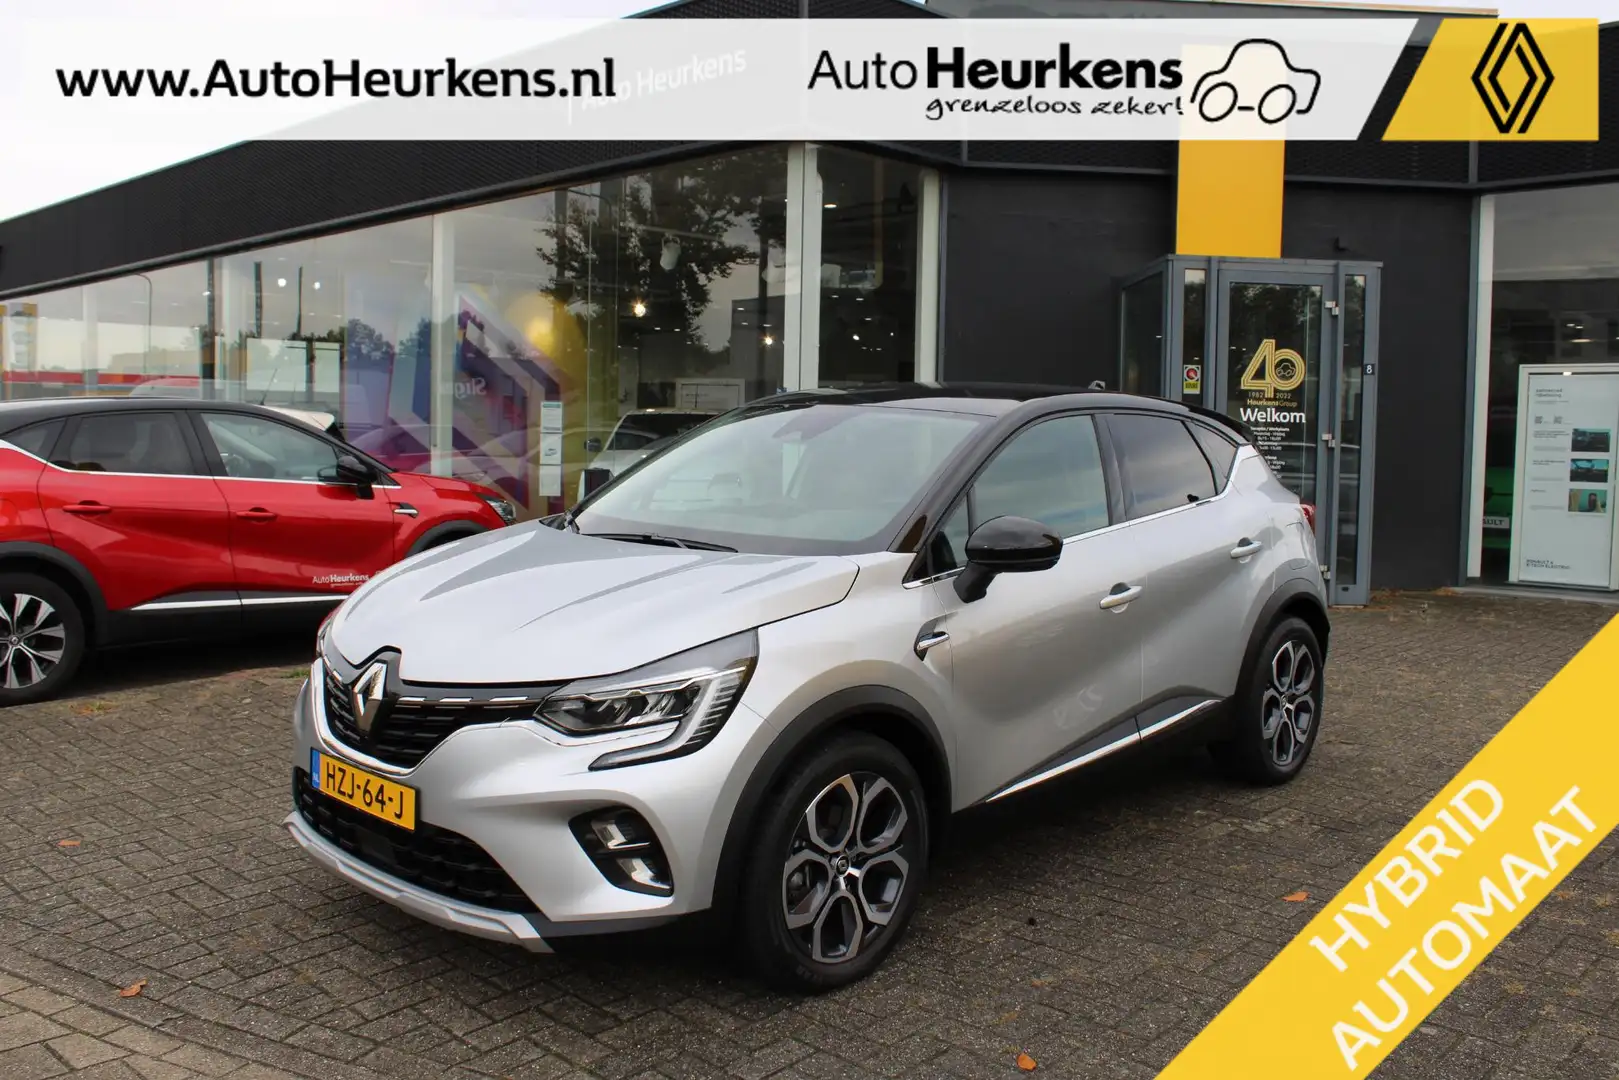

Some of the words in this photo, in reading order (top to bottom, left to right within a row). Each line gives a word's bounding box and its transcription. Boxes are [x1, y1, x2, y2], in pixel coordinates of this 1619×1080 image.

[635, 49, 747, 98] Heurkens
[1366, 364, 1373, 374] 8
[1240, 407, 1306, 423] Welkom
[326, 761, 404, 820] HZJ-64-J
